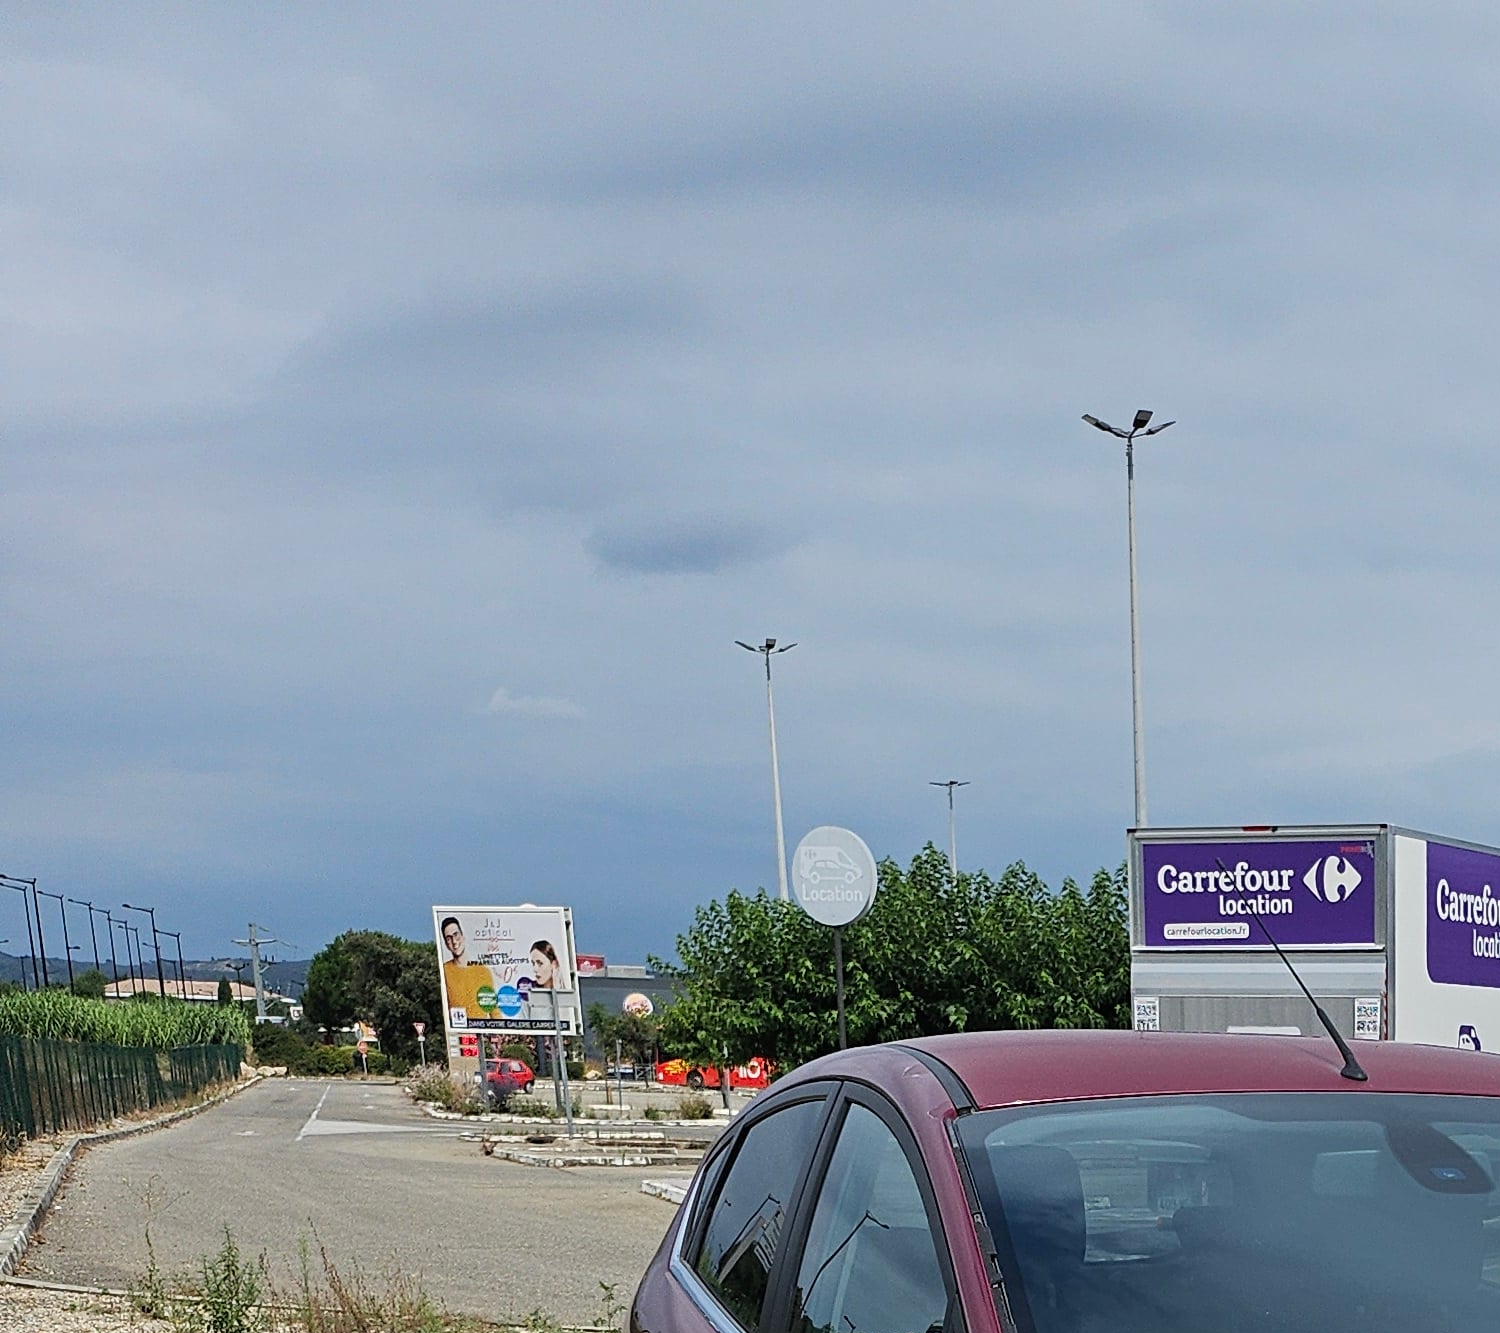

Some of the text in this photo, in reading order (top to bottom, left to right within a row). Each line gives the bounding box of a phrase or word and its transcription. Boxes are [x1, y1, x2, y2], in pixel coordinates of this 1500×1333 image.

[1158, 862, 1294, 893] Carrefour
[802, 883, 863, 901] Location
[1219, 894, 1292, 915] location
[1167, 926, 1246, 936] carrefourlocation.fr
